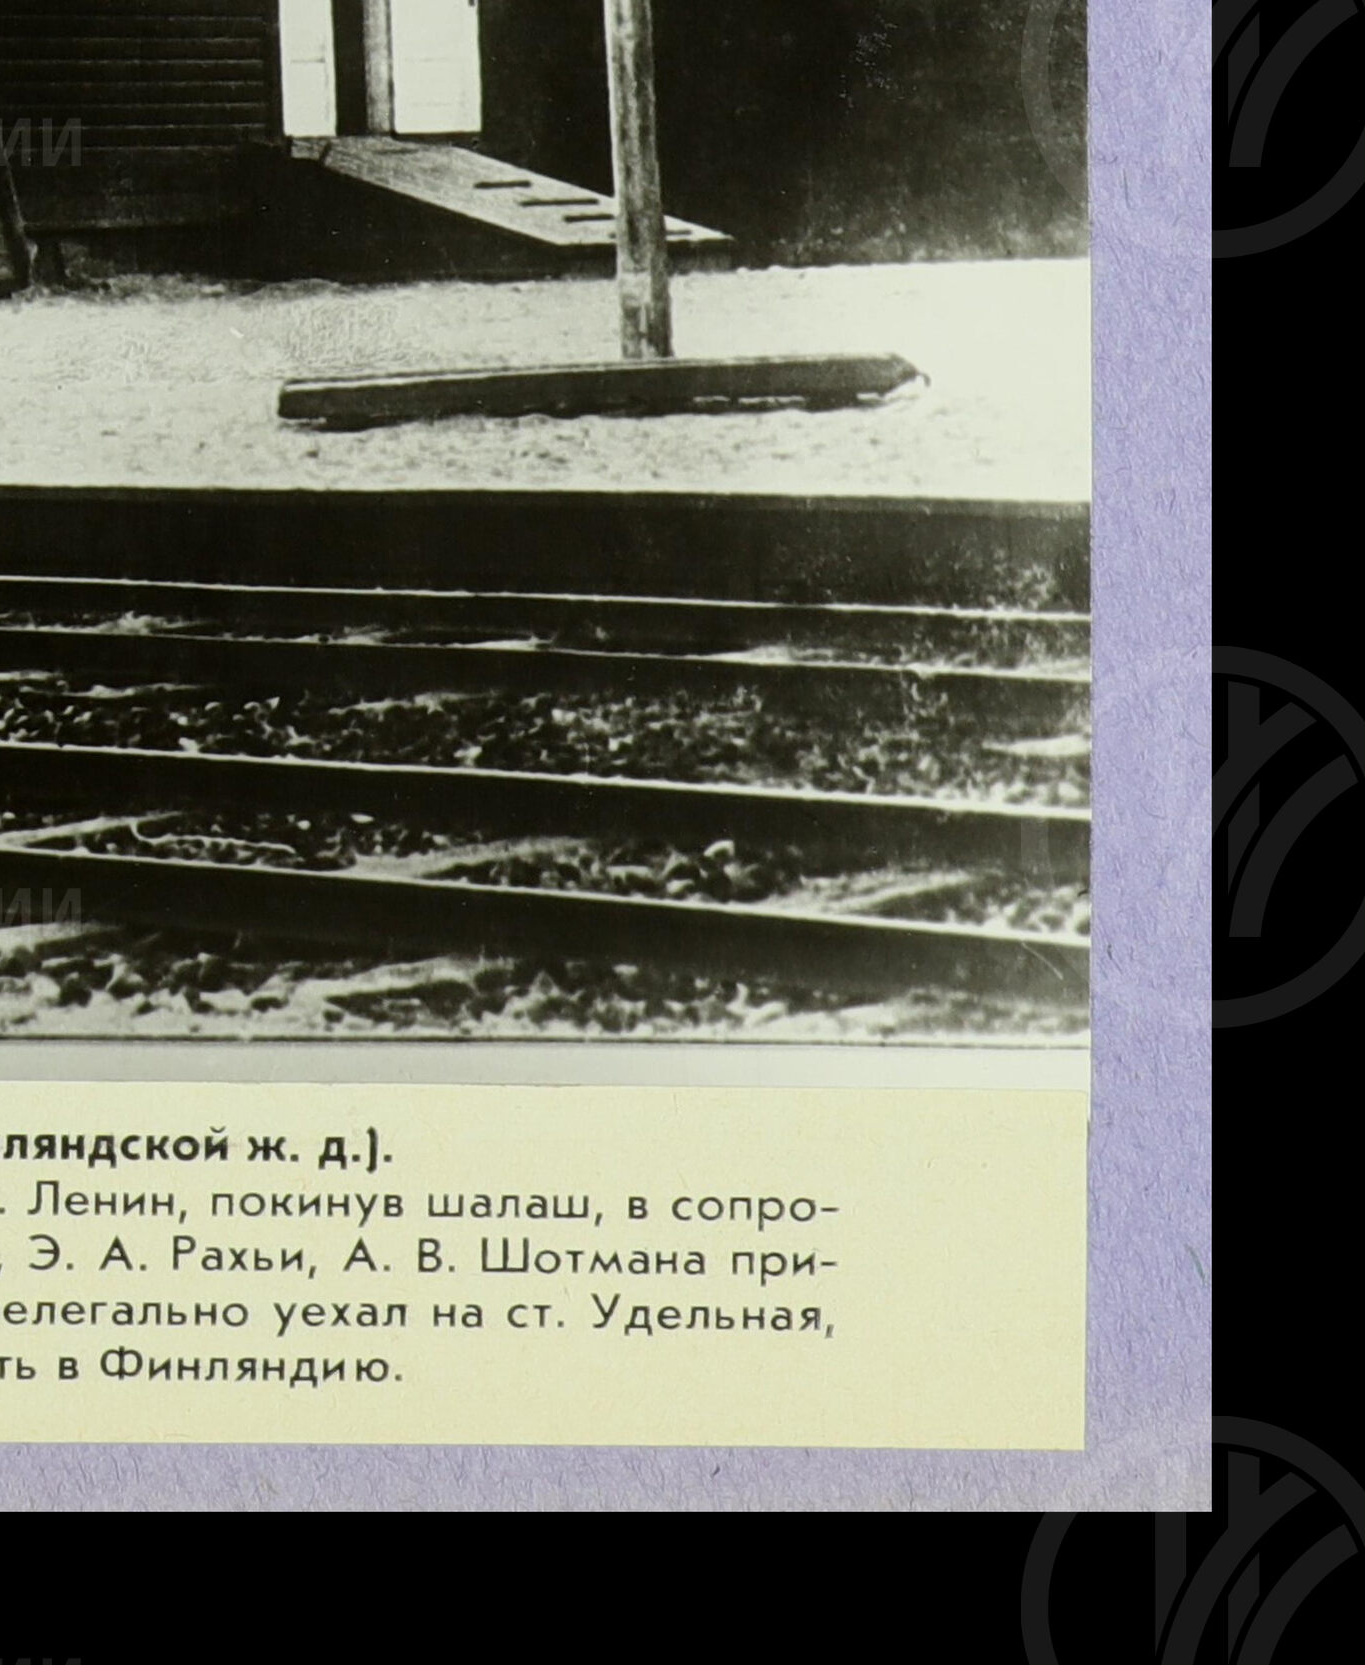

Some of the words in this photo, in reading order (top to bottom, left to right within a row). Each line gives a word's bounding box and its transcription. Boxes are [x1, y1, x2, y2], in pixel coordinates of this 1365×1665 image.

[247, 1136, 299, 1162] ж.
[318, 1127, 392, 1174] д.).
[27, 1180, 187, 1223] Ленин,
[212, 1192, 404, 1227] покинув
[428, 1194, 602, 1226] шалаш,
[628, 1196, 648, 1220] в
[672, 1196, 838, 1231] сопро-
[29, 1234, 73, 1271] Э.
[100, 1236, 146, 1271] А.
[172, 1235, 316, 1279] Рахьи,
[344, 1238, 390, 1271] А.
[418, 1238, 455, 1273] В.
[481, 1237, 705, 1275] Шотмана
[732, 1252, 836, 1286] при-
[274, 1303, 407, 1337] уехал
[433, 1304, 483, 1328] на
[507, 1304, 563, 1328] ст.
[592, 1293, 831, 1336] Удельная,
[58, 1357, 79, 1380] в
[100, 1346, 401, 1388] Финляндию.
